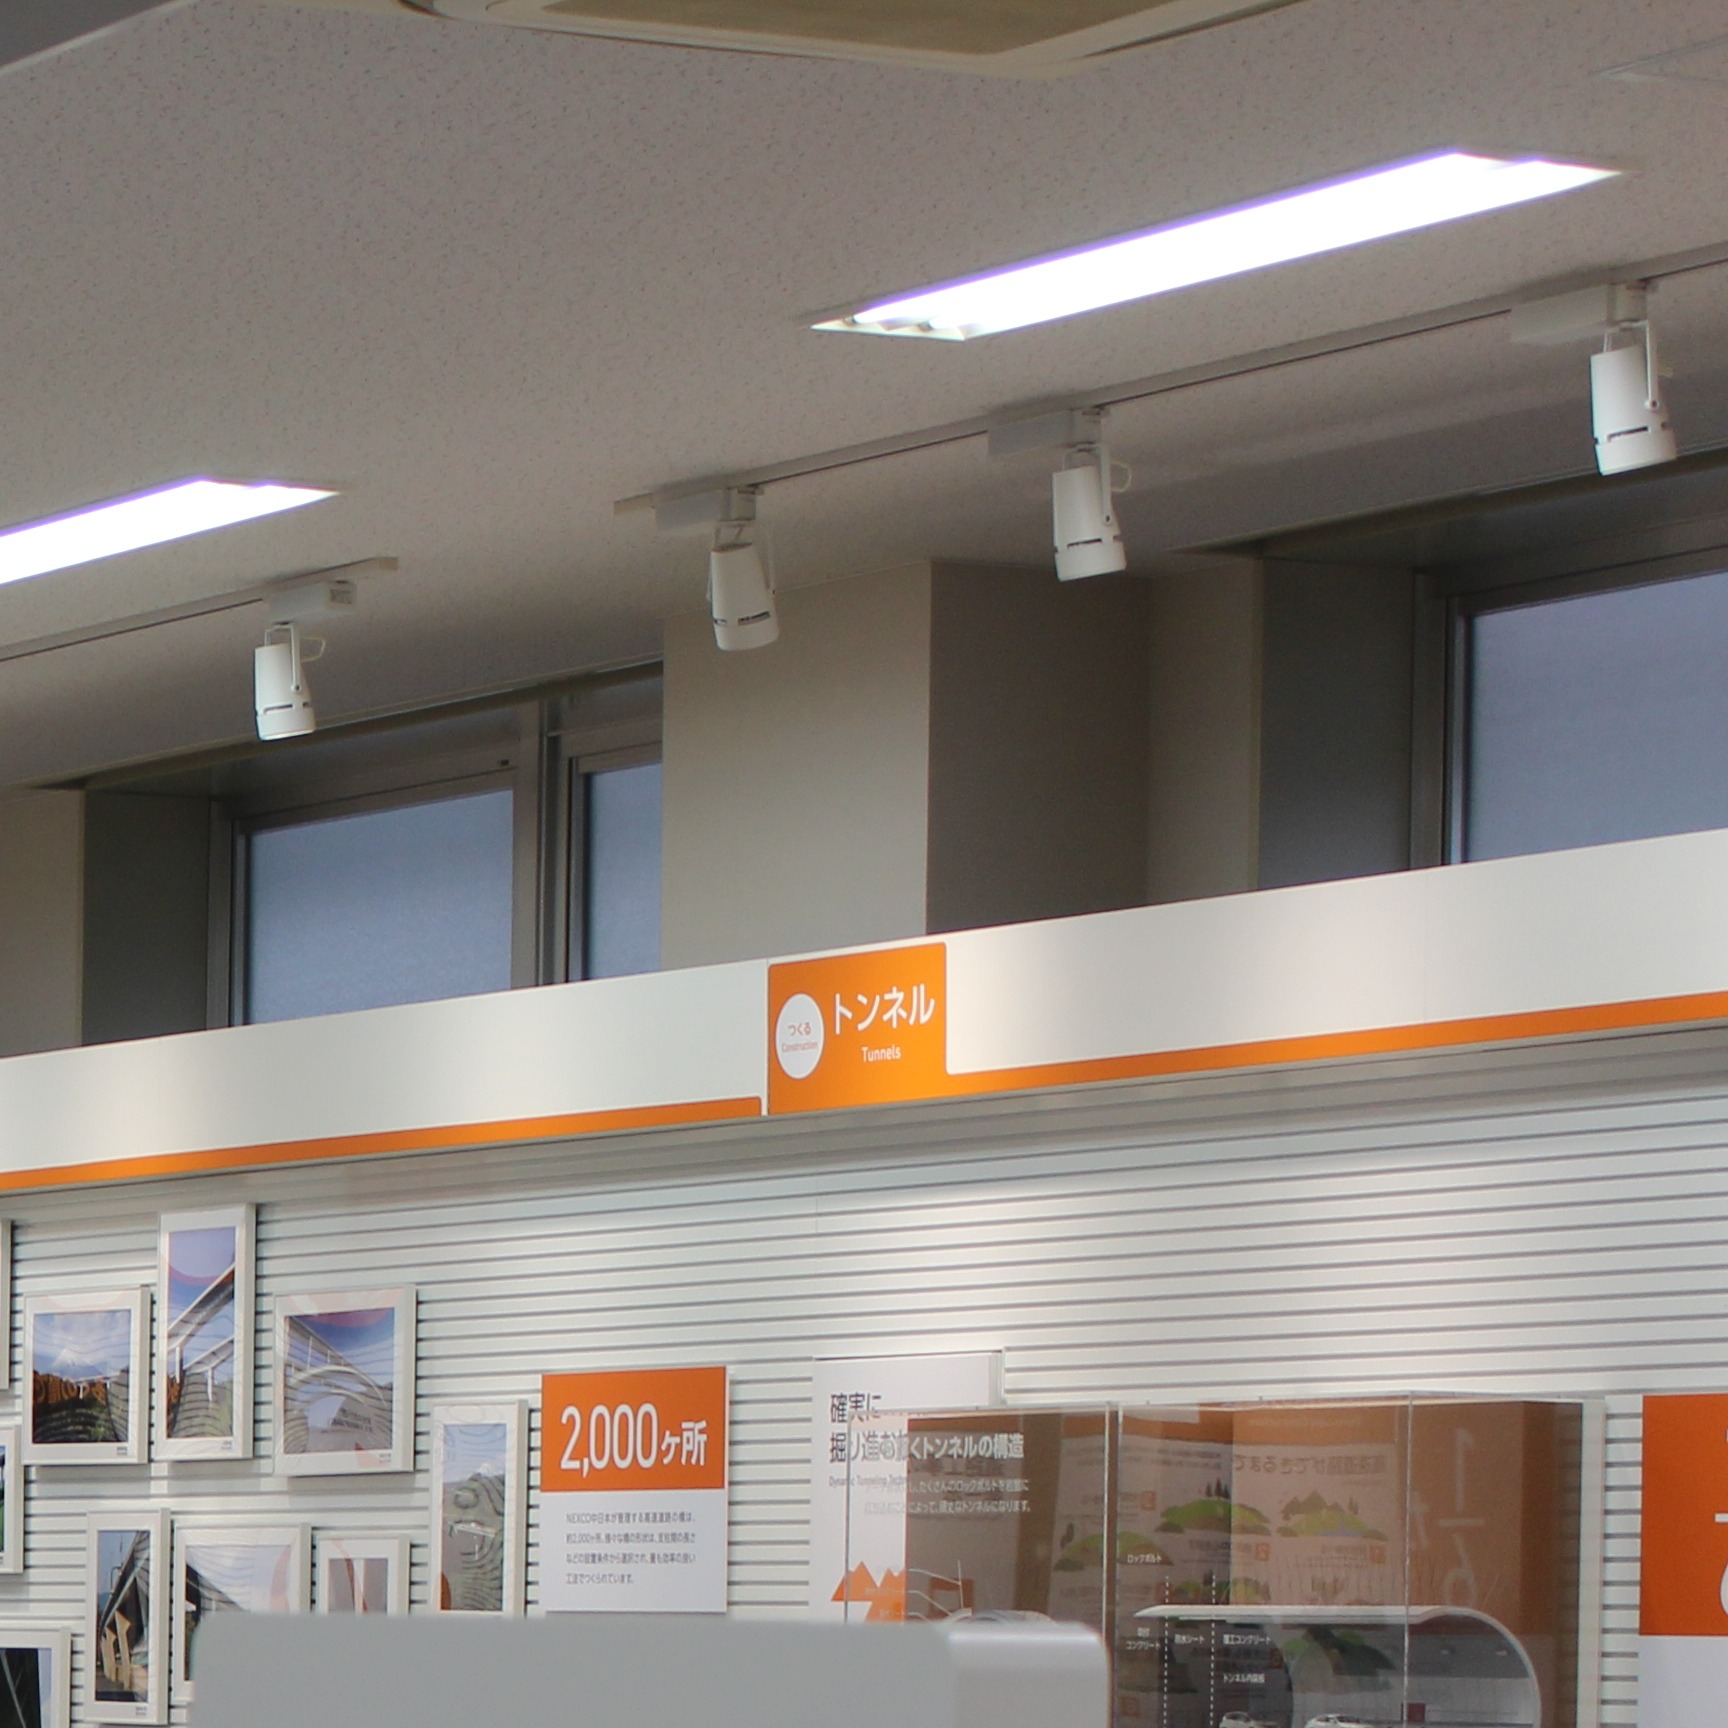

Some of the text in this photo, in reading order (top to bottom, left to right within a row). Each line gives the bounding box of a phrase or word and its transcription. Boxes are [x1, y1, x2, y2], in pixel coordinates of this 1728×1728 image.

[834, 984, 935, 1035] トンネル
[788, 1023, 811, 1036] つくる
[861, 1045, 901, 1062] Tunnels
